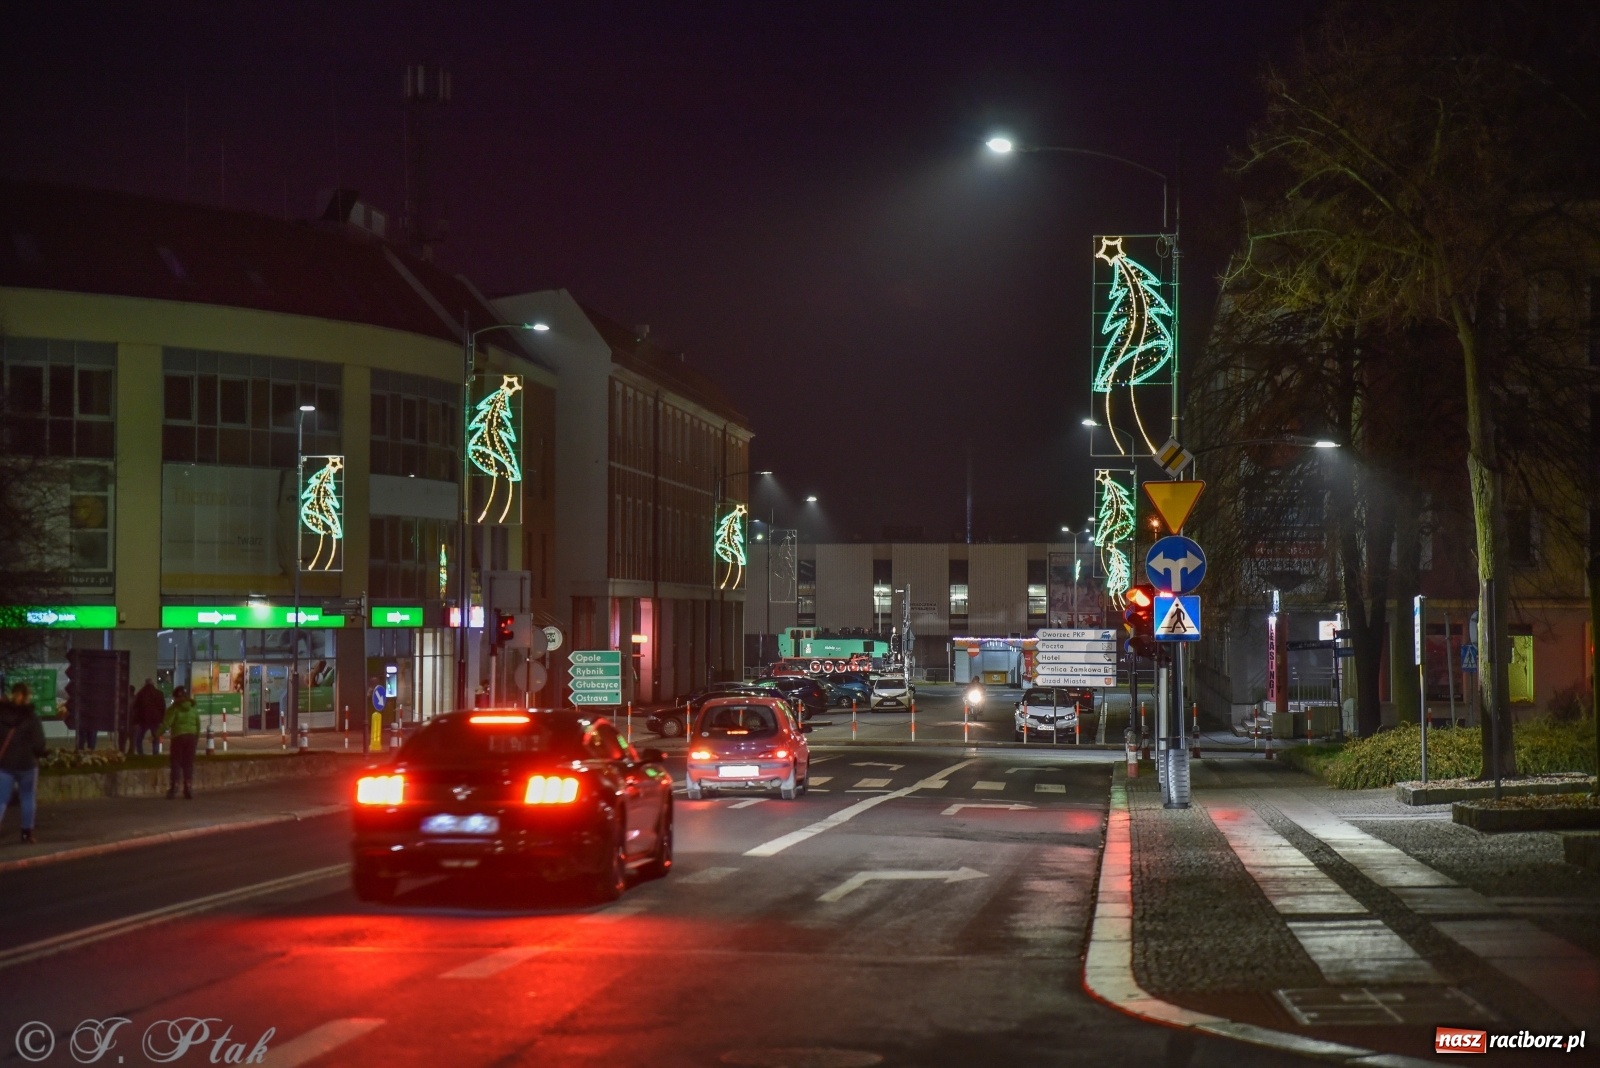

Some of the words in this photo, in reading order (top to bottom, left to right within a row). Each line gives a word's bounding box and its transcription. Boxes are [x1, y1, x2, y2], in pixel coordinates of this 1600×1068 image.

[576, 654, 602, 663] Opole
[576, 668, 604, 677] Rybnik
[575, 680, 619, 689] Głubczyce
[575, 694, 608, 702] Ostrava
